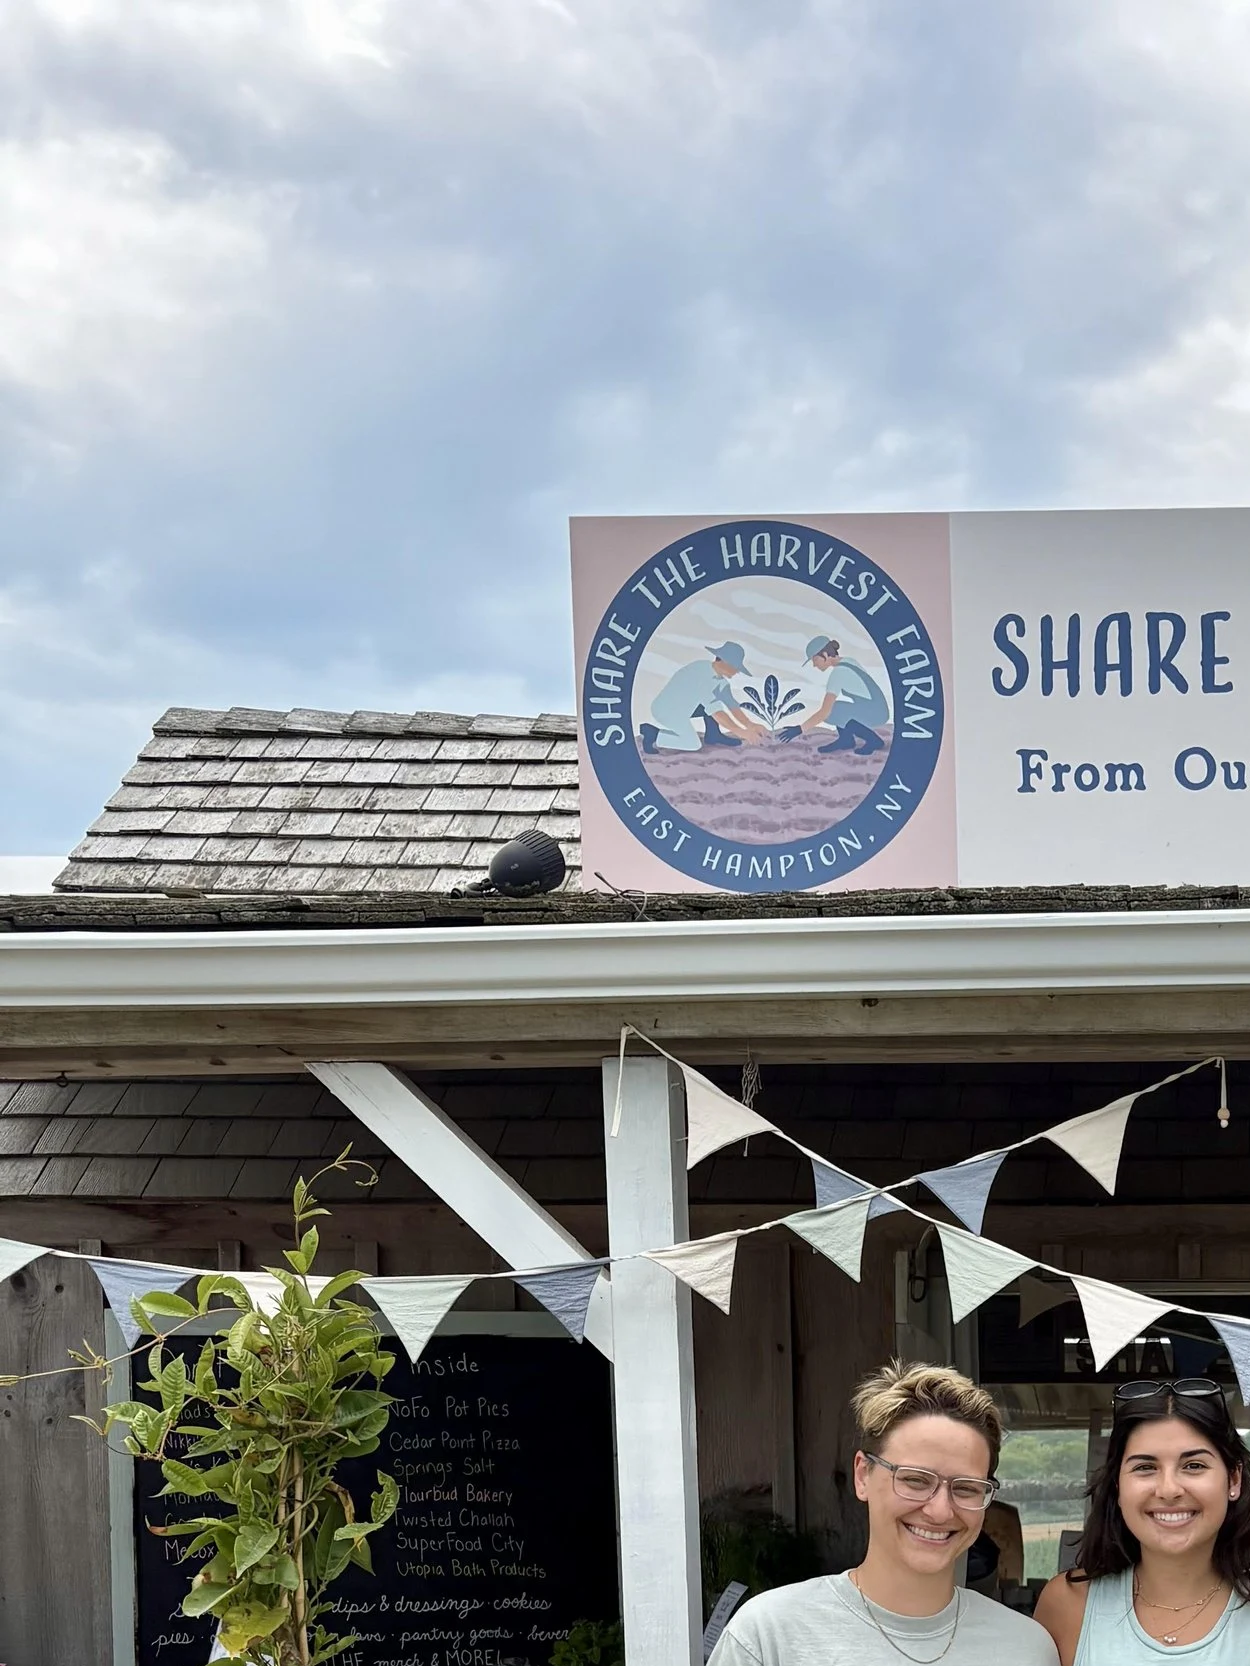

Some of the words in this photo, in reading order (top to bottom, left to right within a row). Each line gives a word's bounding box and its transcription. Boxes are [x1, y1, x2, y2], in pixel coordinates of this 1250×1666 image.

[592, 613, 641, 747] SHARE
[631, 547, 706, 607] THE
[720, 532, 898, 617] HARVEST
[885, 623, 936, 741] FARM
[991, 612, 1234, 698] SHARE
[1015, 748, 1147, 793] From
[623, 786, 690, 853] EAST
[701, 829, 877, 880] HAMPTON,
[876, 774, 915, 821] NY
[445, 1396, 469, 1418] Pot
[477, 1397, 510, 1417] Pies
[389, 1432, 436, 1452] Cedar
[441, 1431, 476, 1450] Point
[482, 1430, 521, 1451] Pizza
[393, 1459, 452, 1488] Springs
[462, 1457, 496, 1475] Salt
[466, 1483, 514, 1506] Bakery
[459, 1508, 515, 1528] Challah
[492, 1532, 525, 1560] City
[396, 1561, 445, 1580] Utopia
[451, 1559, 487, 1578] Bath
[490, 1558, 547, 1579] Products
[332, 1596, 376, 1621] dips
[379, 1595, 391, 1611] &
[394, 1598, 484, 1619] dressings
[493, 1592, 552, 1611] cookies
[151, 1631, 196, 1658] pies
[399, 1627, 465, 1650] pantry
[469, 1626, 514, 1646] goods
[430, 1653, 441, 1666] &
